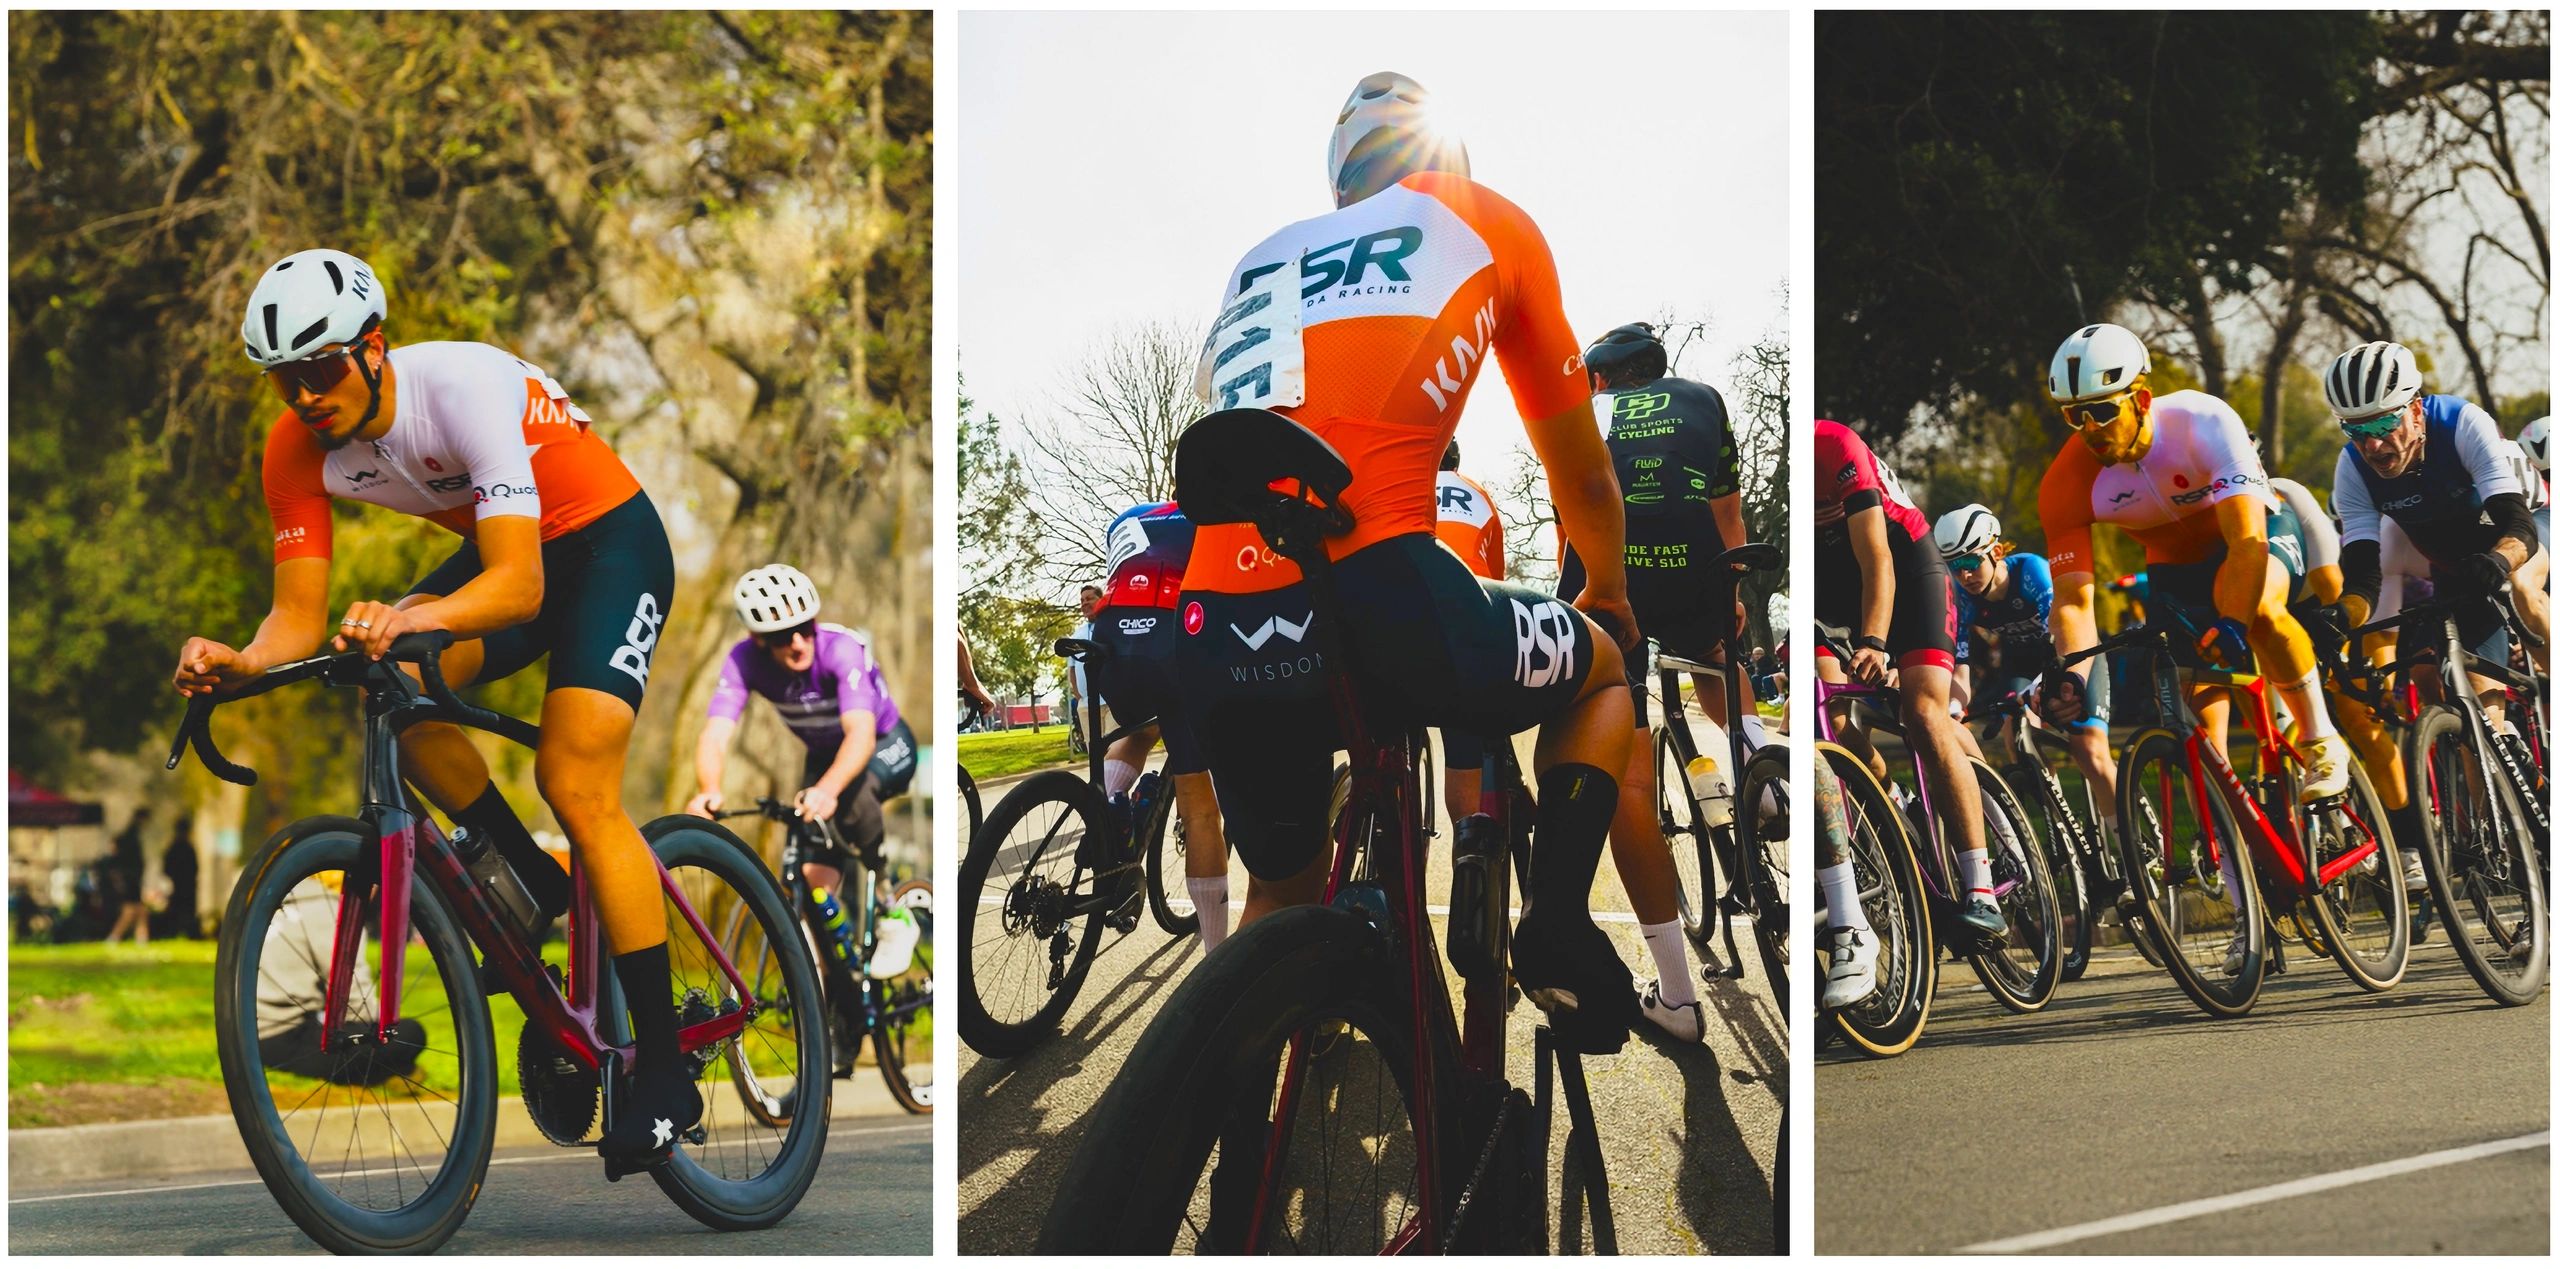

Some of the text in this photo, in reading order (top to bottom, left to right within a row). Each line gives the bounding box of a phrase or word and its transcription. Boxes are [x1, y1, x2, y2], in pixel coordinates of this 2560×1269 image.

[1338, 285, 1411, 299] RACING
[1641, 418, 1683, 428] SPORTS
[1619, 426, 1675, 440] CYCLING
[1623, 543, 1688, 555] IDE FAST
[1623, 556, 1687, 568] IVE SLO
[1118, 617, 1157, 629] CHICO
[608, 591, 663, 698] RSR
[1510, 597, 1576, 688] RSR
